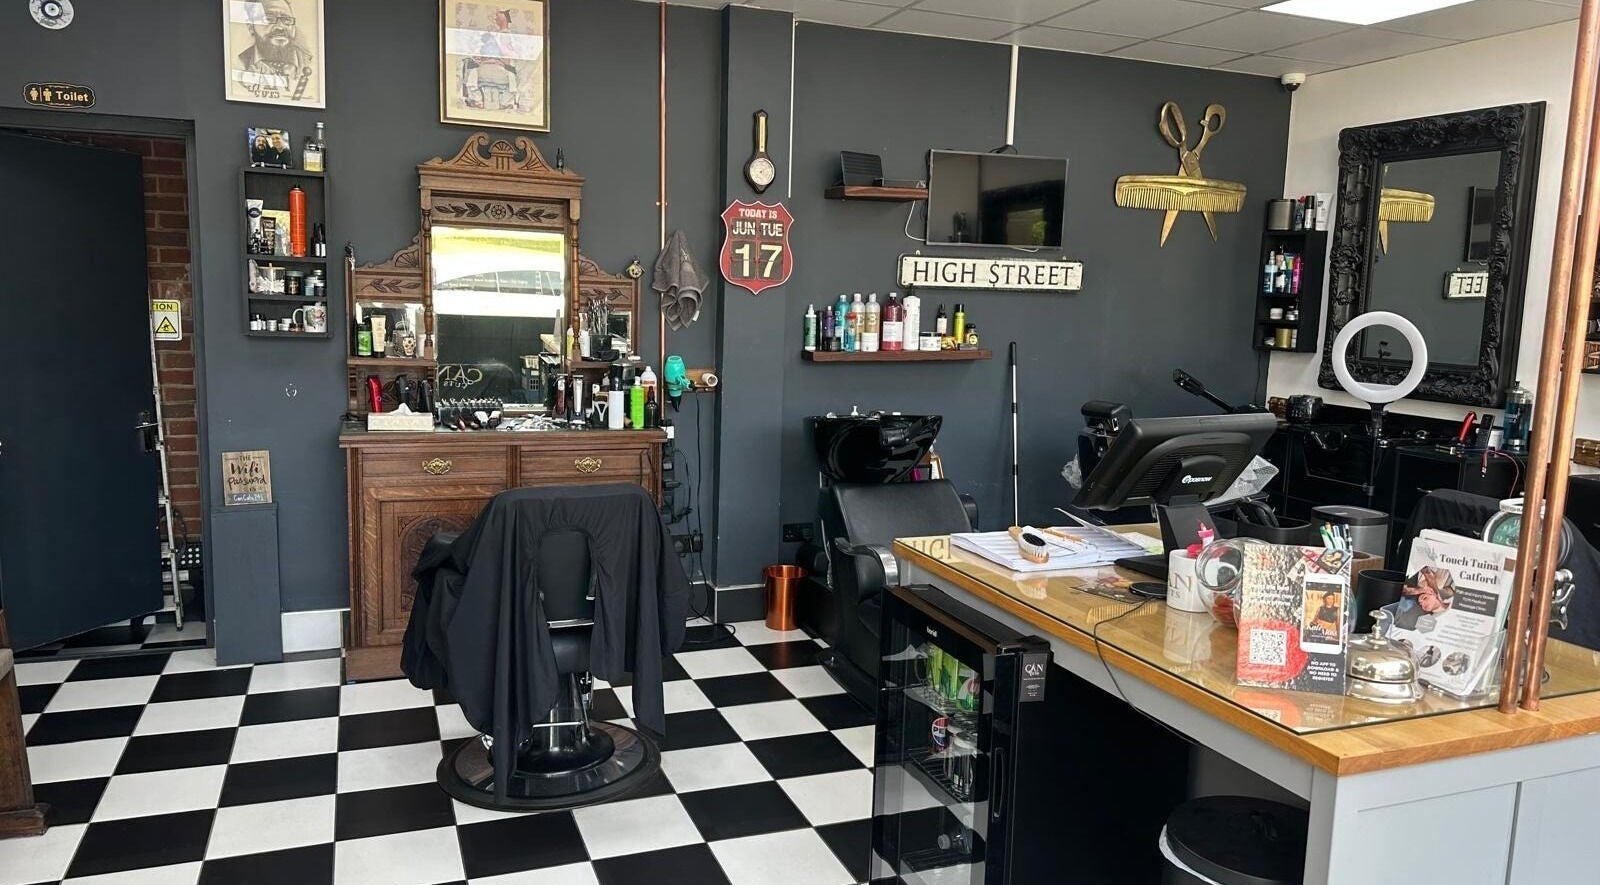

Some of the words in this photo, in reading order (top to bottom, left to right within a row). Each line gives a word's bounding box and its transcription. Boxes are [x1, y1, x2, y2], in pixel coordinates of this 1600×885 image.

[55, 90, 89, 102] Toilet
[738, 208, 768, 219] TODAY
[768, 210, 778, 219] IS
[732, 221, 756, 236] JUN
[760, 222, 783, 237] TUE
[913, 261, 977, 284] HIGH
[988, 263, 1074, 286] STREET
[1439, 554, 1469, 567] Touch
[1469, 558, 1499, 572] Tuina
[1459, 570, 1498, 585] Catford
[1025, 662, 1045, 672] CAN
